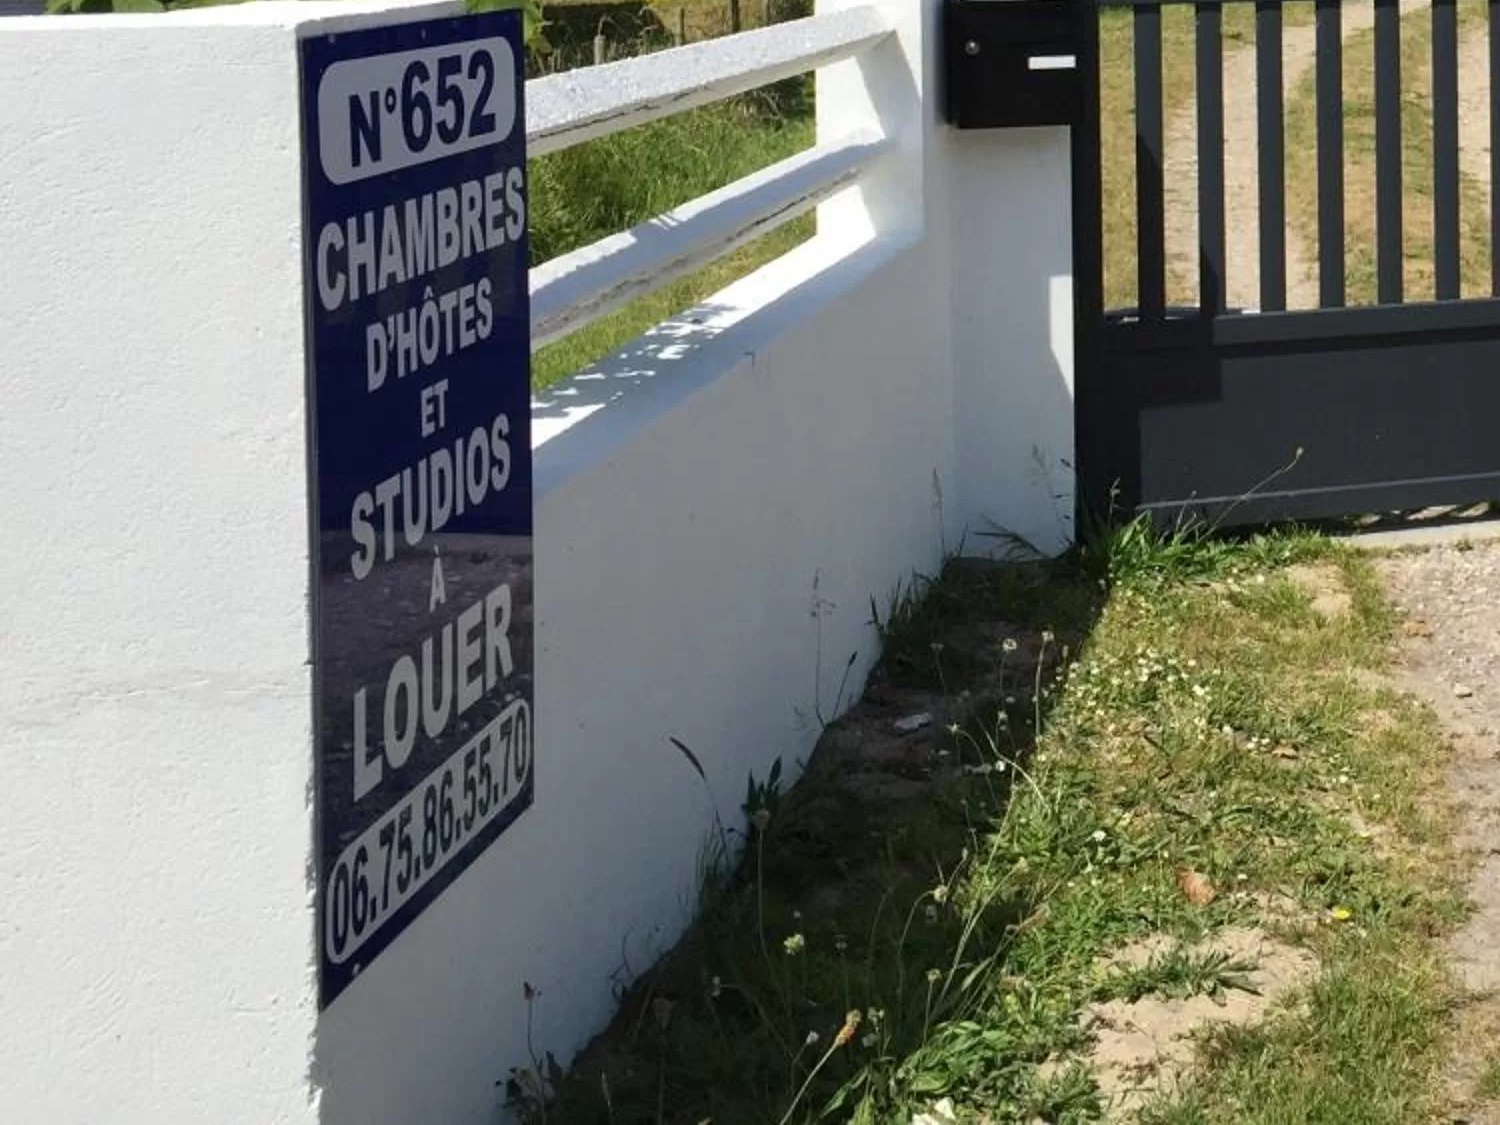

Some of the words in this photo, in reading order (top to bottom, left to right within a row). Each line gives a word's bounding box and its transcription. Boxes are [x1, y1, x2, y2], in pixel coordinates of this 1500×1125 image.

[348, 49, 497, 168] N°652
[316, 166, 526, 312] CHAMBRES
[366, 277, 494, 393] D'HÔTES
[420, 378, 450, 439] ET
[350, 413, 512, 581] STUDIOS
[428, 544, 447, 613] À
[353, 582, 514, 803] LOUER
[330, 706, 530, 957] 06.75.86.55.70
